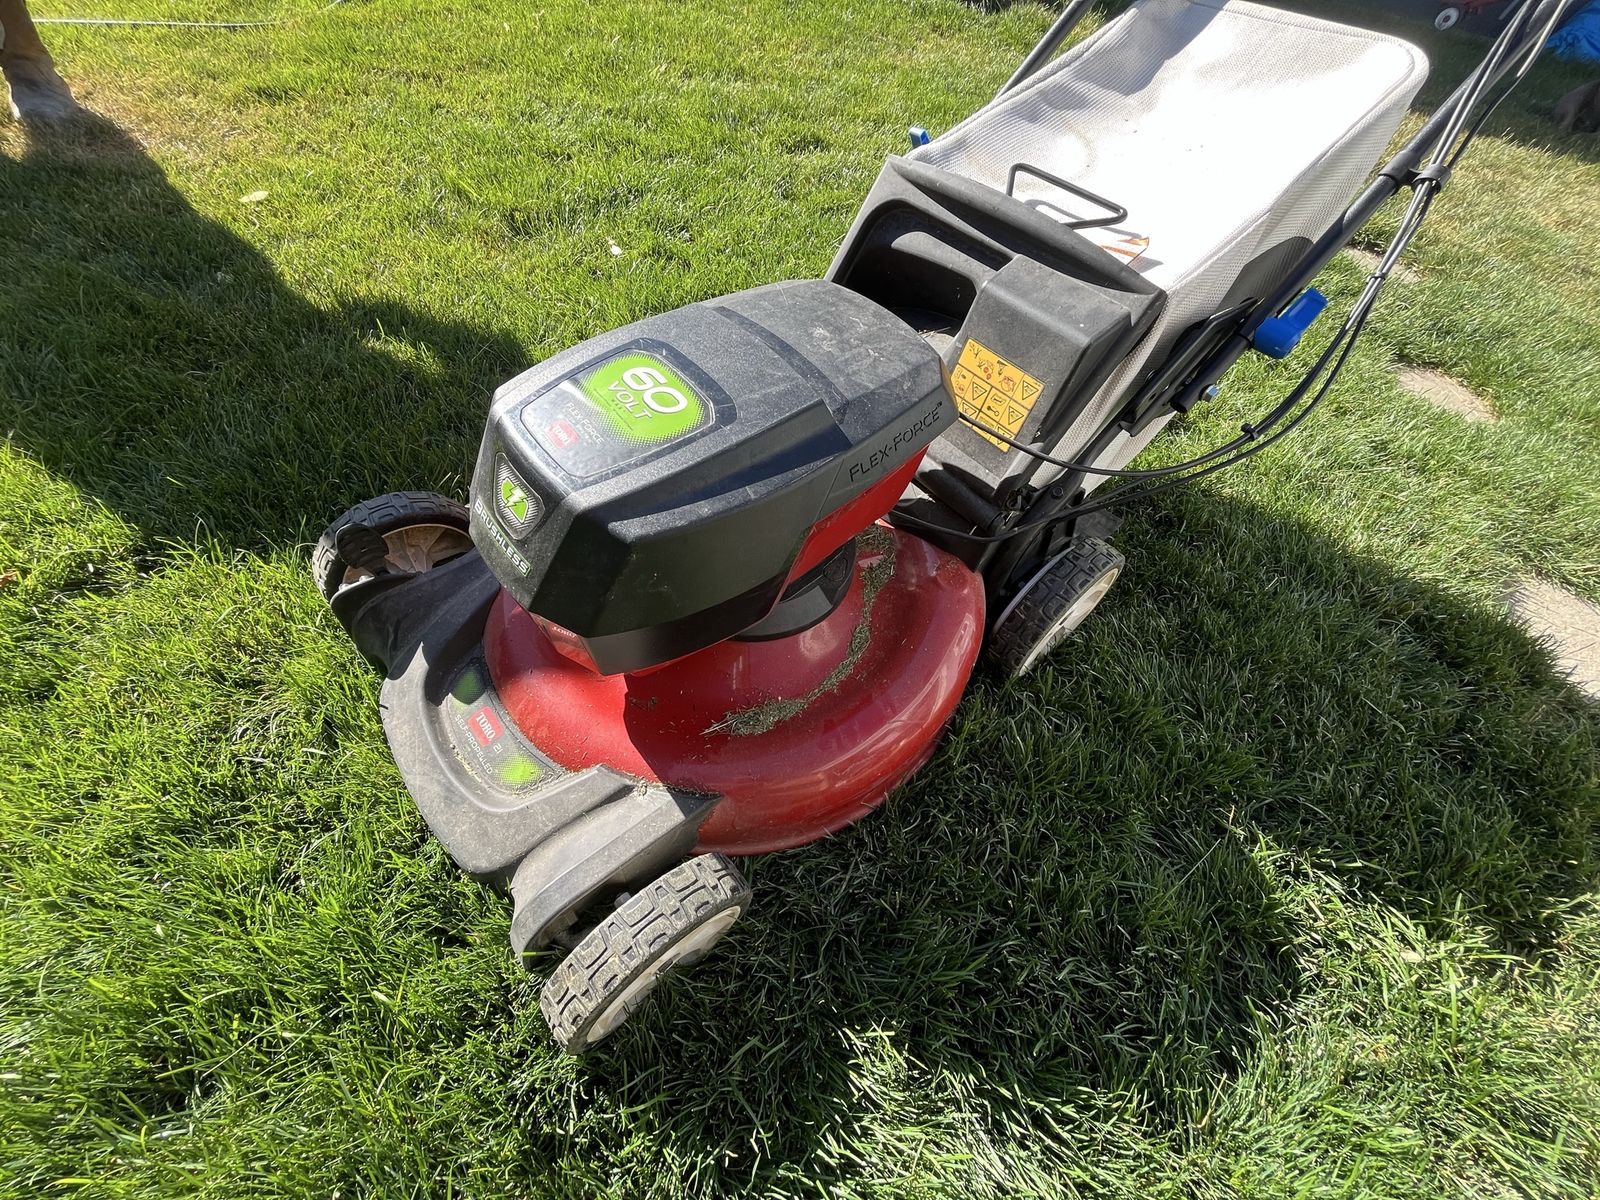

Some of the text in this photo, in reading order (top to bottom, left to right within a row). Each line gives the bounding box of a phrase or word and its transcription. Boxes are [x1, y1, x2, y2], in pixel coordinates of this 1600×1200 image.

[608, 380, 653, 418] VOLT
[622, 366, 688, 414] 60
[474, 498, 529, 574] BRUSHLESS
[455, 714, 493, 775] SELF-PROPELLED
[476, 711, 497, 740] TORO
